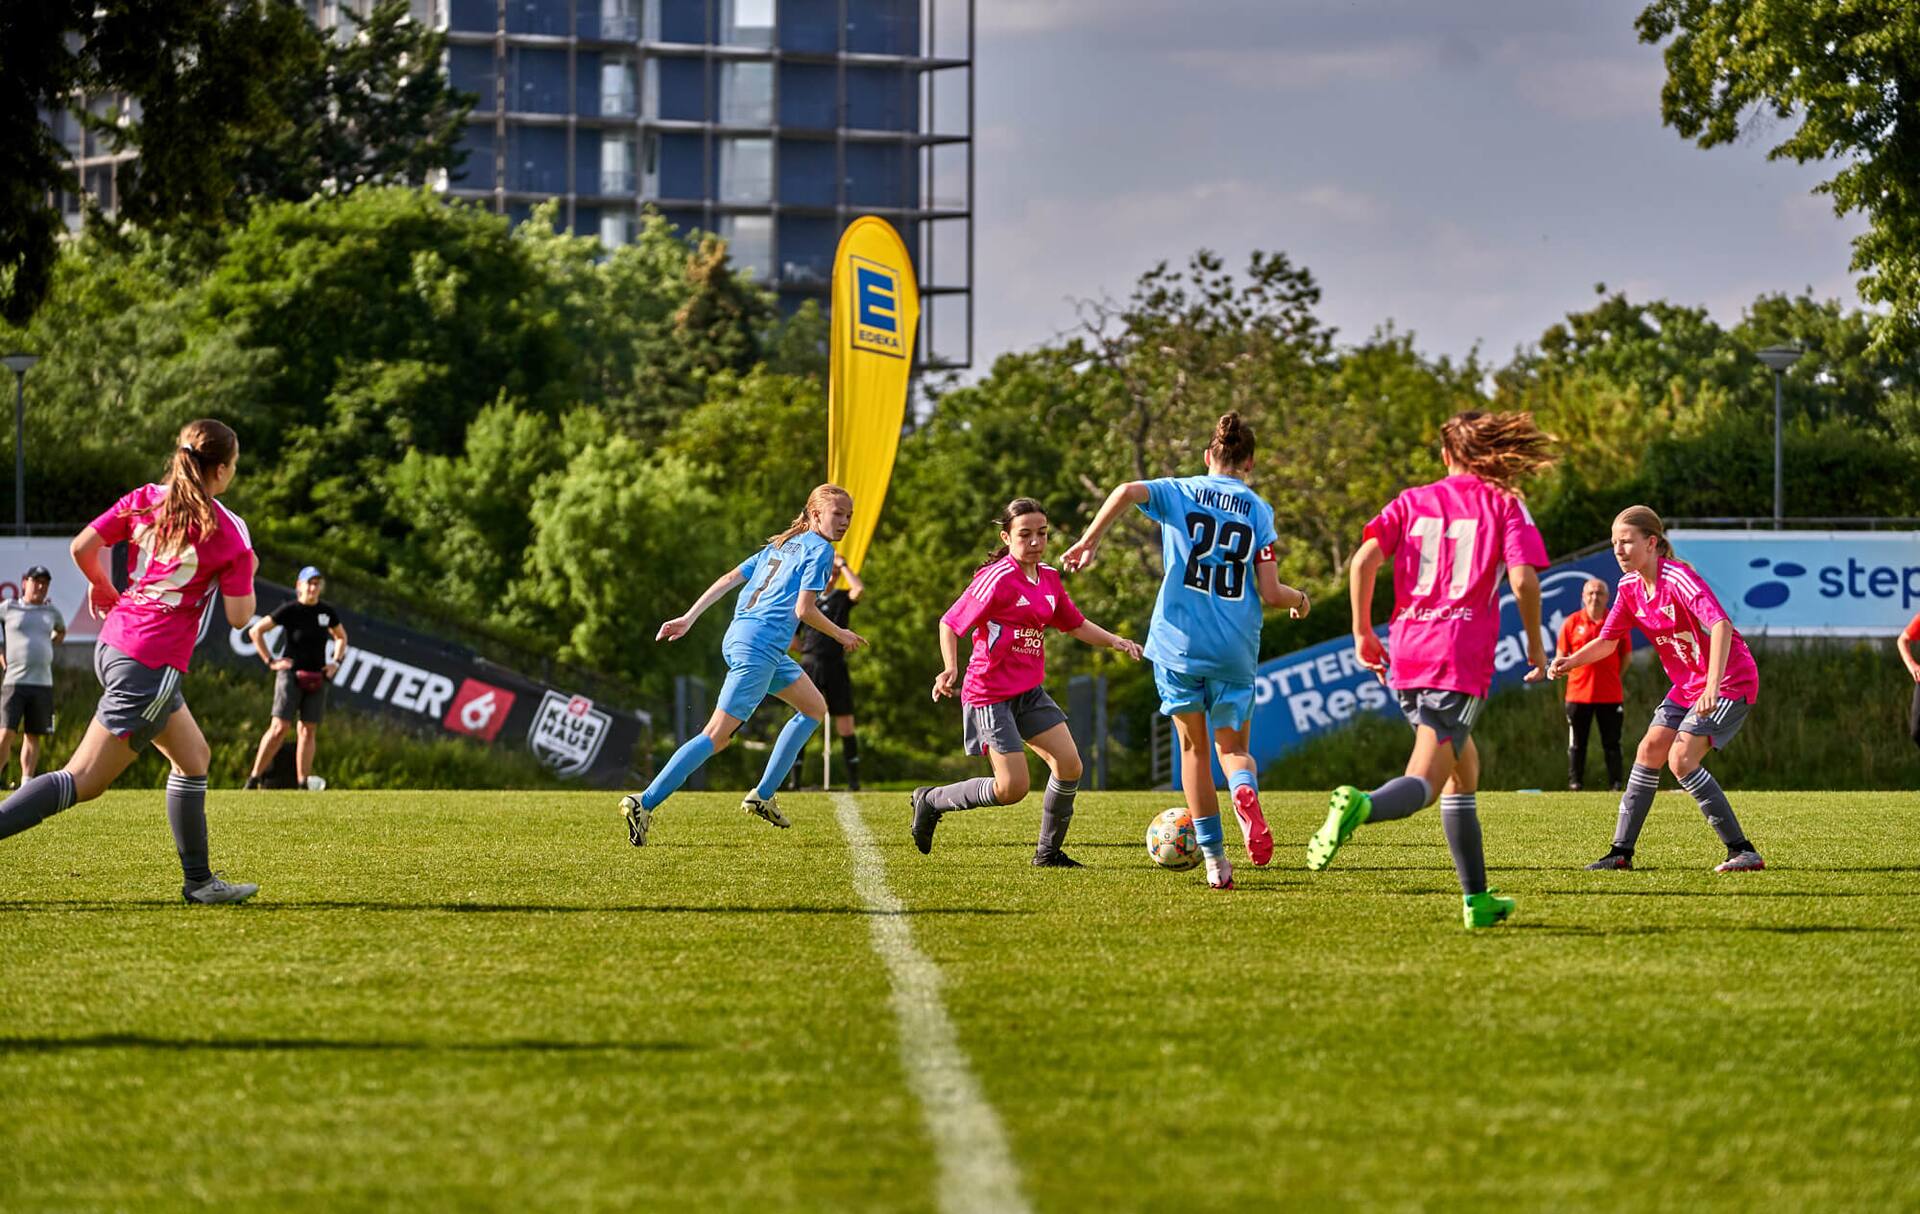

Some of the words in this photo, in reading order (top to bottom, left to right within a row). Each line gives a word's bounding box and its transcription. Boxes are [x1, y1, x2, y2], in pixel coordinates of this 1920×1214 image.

[858, 267, 897, 332] E
[859, 330, 899, 347] EDEKA
[1195, 488, 1251, 517] VIKTORIA
[1184, 511, 1255, 601] 23
[1260, 546, 1272, 560] C
[1409, 516, 1478, 600] 11
[744, 557, 782, 611] 7
[541, 722, 588, 751] HAUS
[547, 708, 596, 738] KLUB
